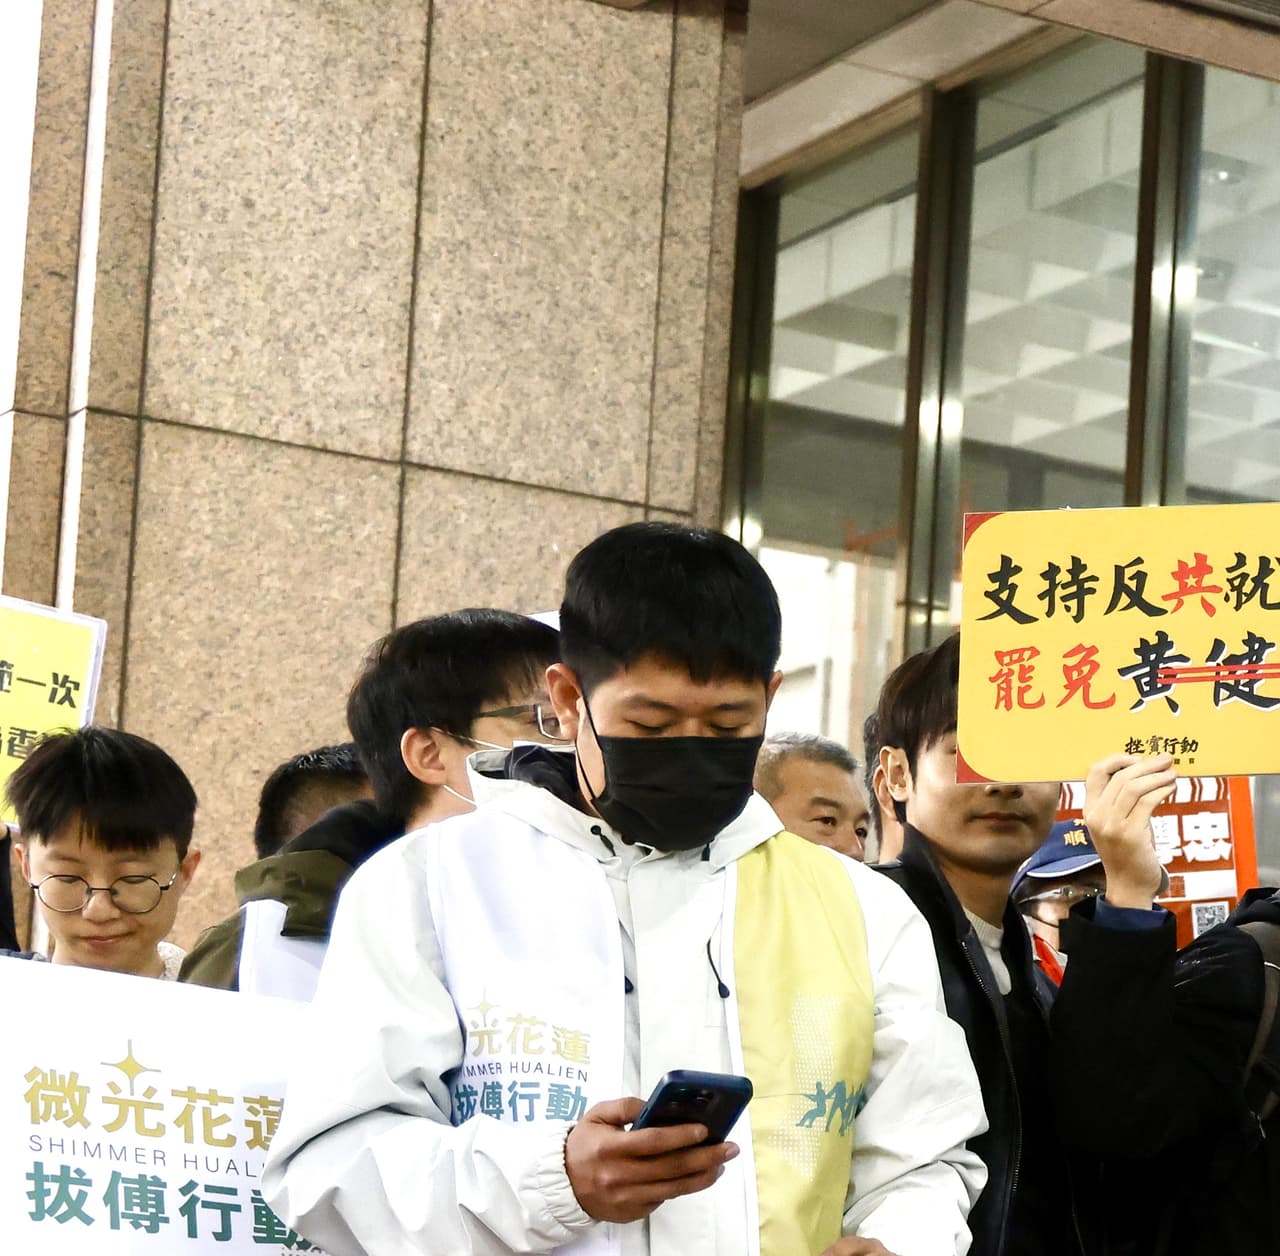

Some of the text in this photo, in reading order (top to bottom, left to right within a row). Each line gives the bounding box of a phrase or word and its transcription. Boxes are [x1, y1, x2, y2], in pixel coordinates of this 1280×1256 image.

[466, 1010, 592, 1065] 光花蓮
[509, 1062, 588, 1084] HUALIEN
[23, 1066, 284, 1152] 微光花蓮
[454, 1079, 588, 1125] 拔傅行動
[28, 1134, 263, 1178] SHIMMER HUAL
[24, 1160, 312, 1253] 拔傅行動
